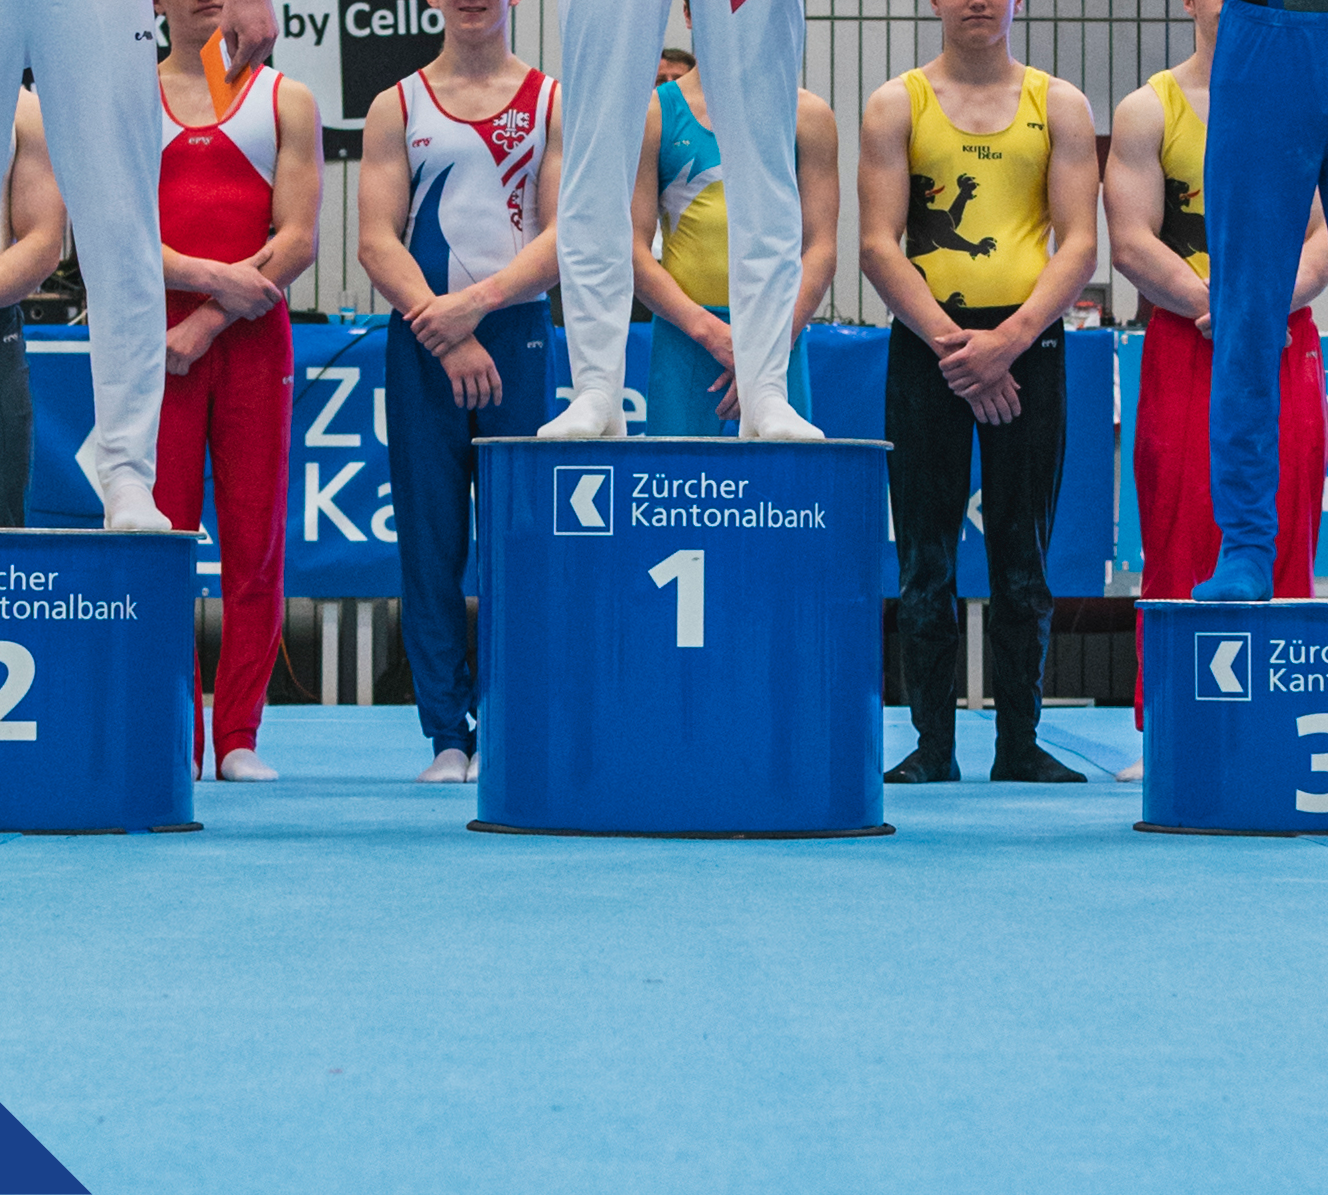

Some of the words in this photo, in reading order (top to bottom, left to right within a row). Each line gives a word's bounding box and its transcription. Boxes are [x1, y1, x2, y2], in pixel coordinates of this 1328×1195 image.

[284, 4, 330, 46] by
[632, 472, 749, 499] Zürcher
[632, 501, 826, 529] Kantonalbank
[648, 549, 705, 647] 1
